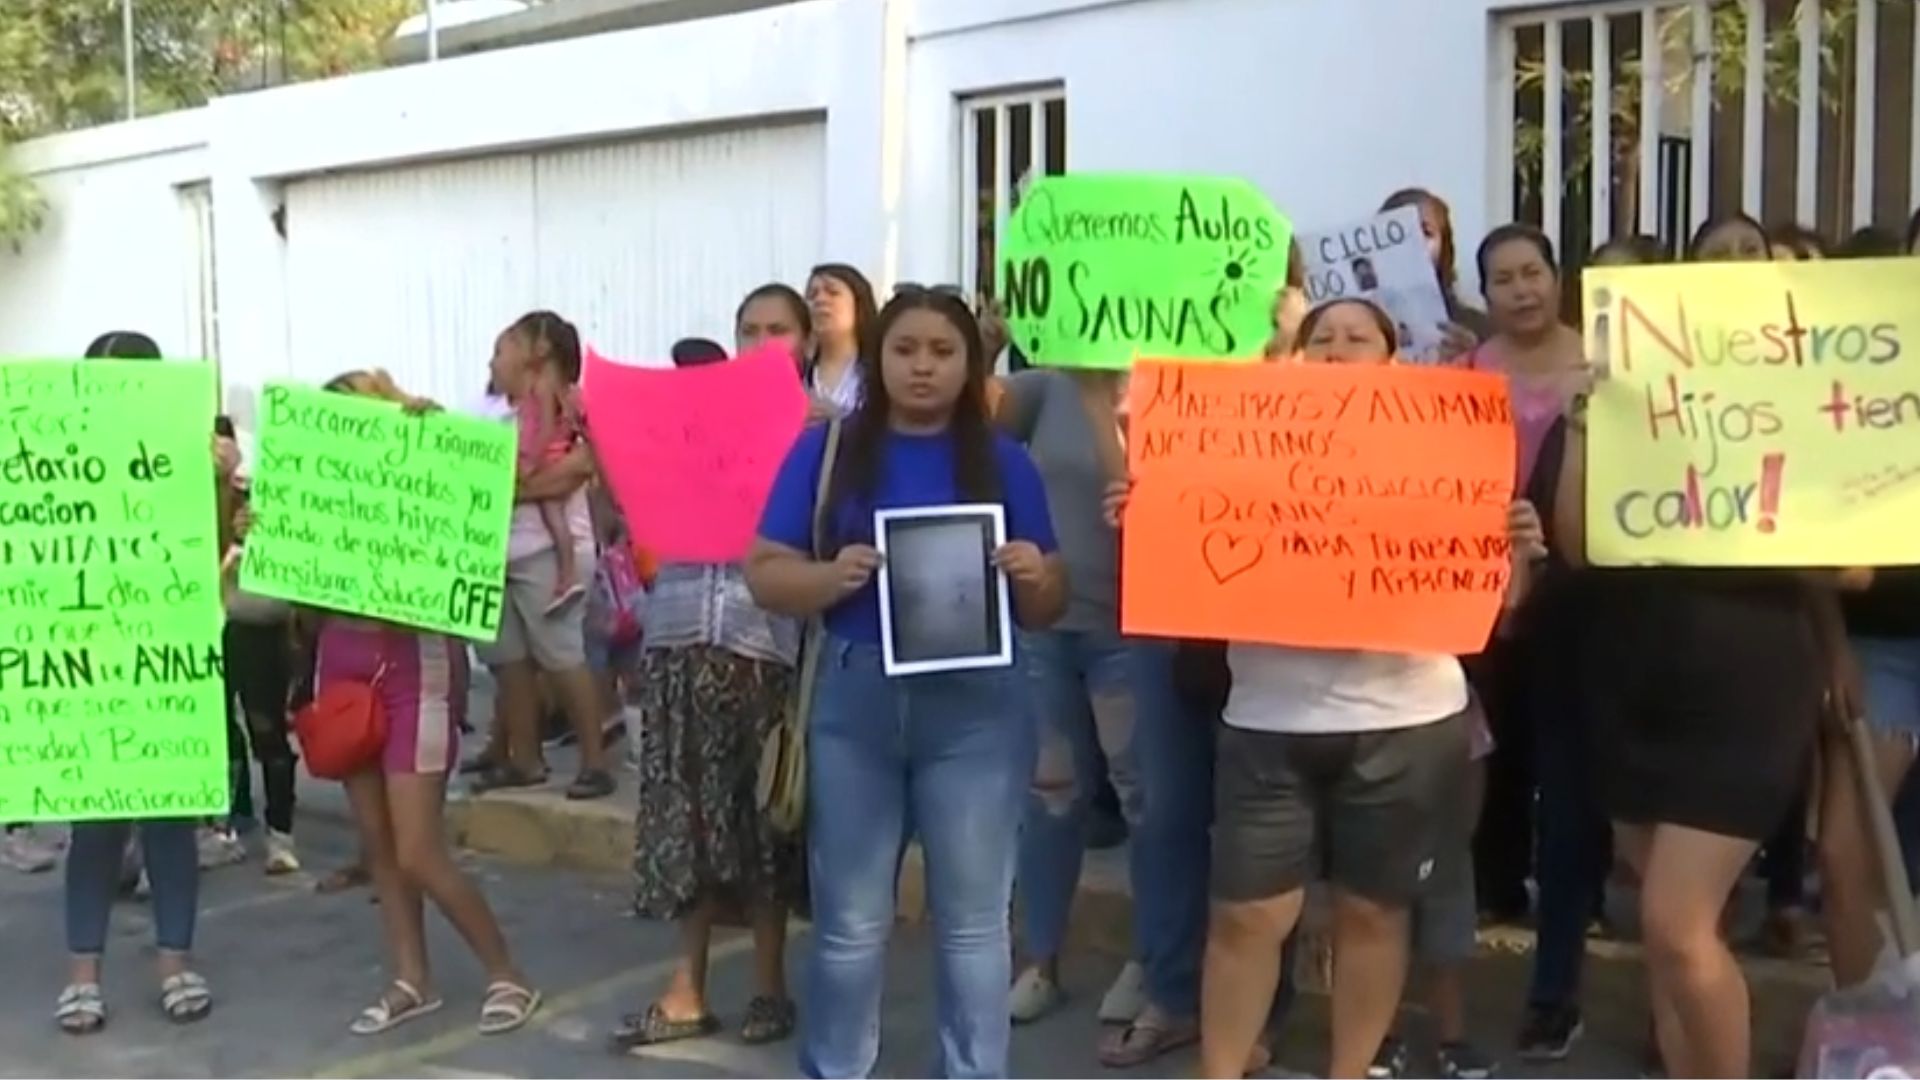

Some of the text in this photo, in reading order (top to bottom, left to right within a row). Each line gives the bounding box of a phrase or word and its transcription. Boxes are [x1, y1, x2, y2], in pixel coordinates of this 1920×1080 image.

[1174, 186, 1274, 250] Aulas
[1319, 220, 1405, 264] CICLO
[1004, 256, 1050, 320] NO
[1647, 374, 1783, 477] Hijos
[0, 436, 174, 484] etario de
[1615, 453, 1785, 538] calor!
[59, 567, 105, 612] 1
[163, 564, 201, 606] de
[448, 576, 503, 630] CFE
[0, 646, 95, 690] PLAN
